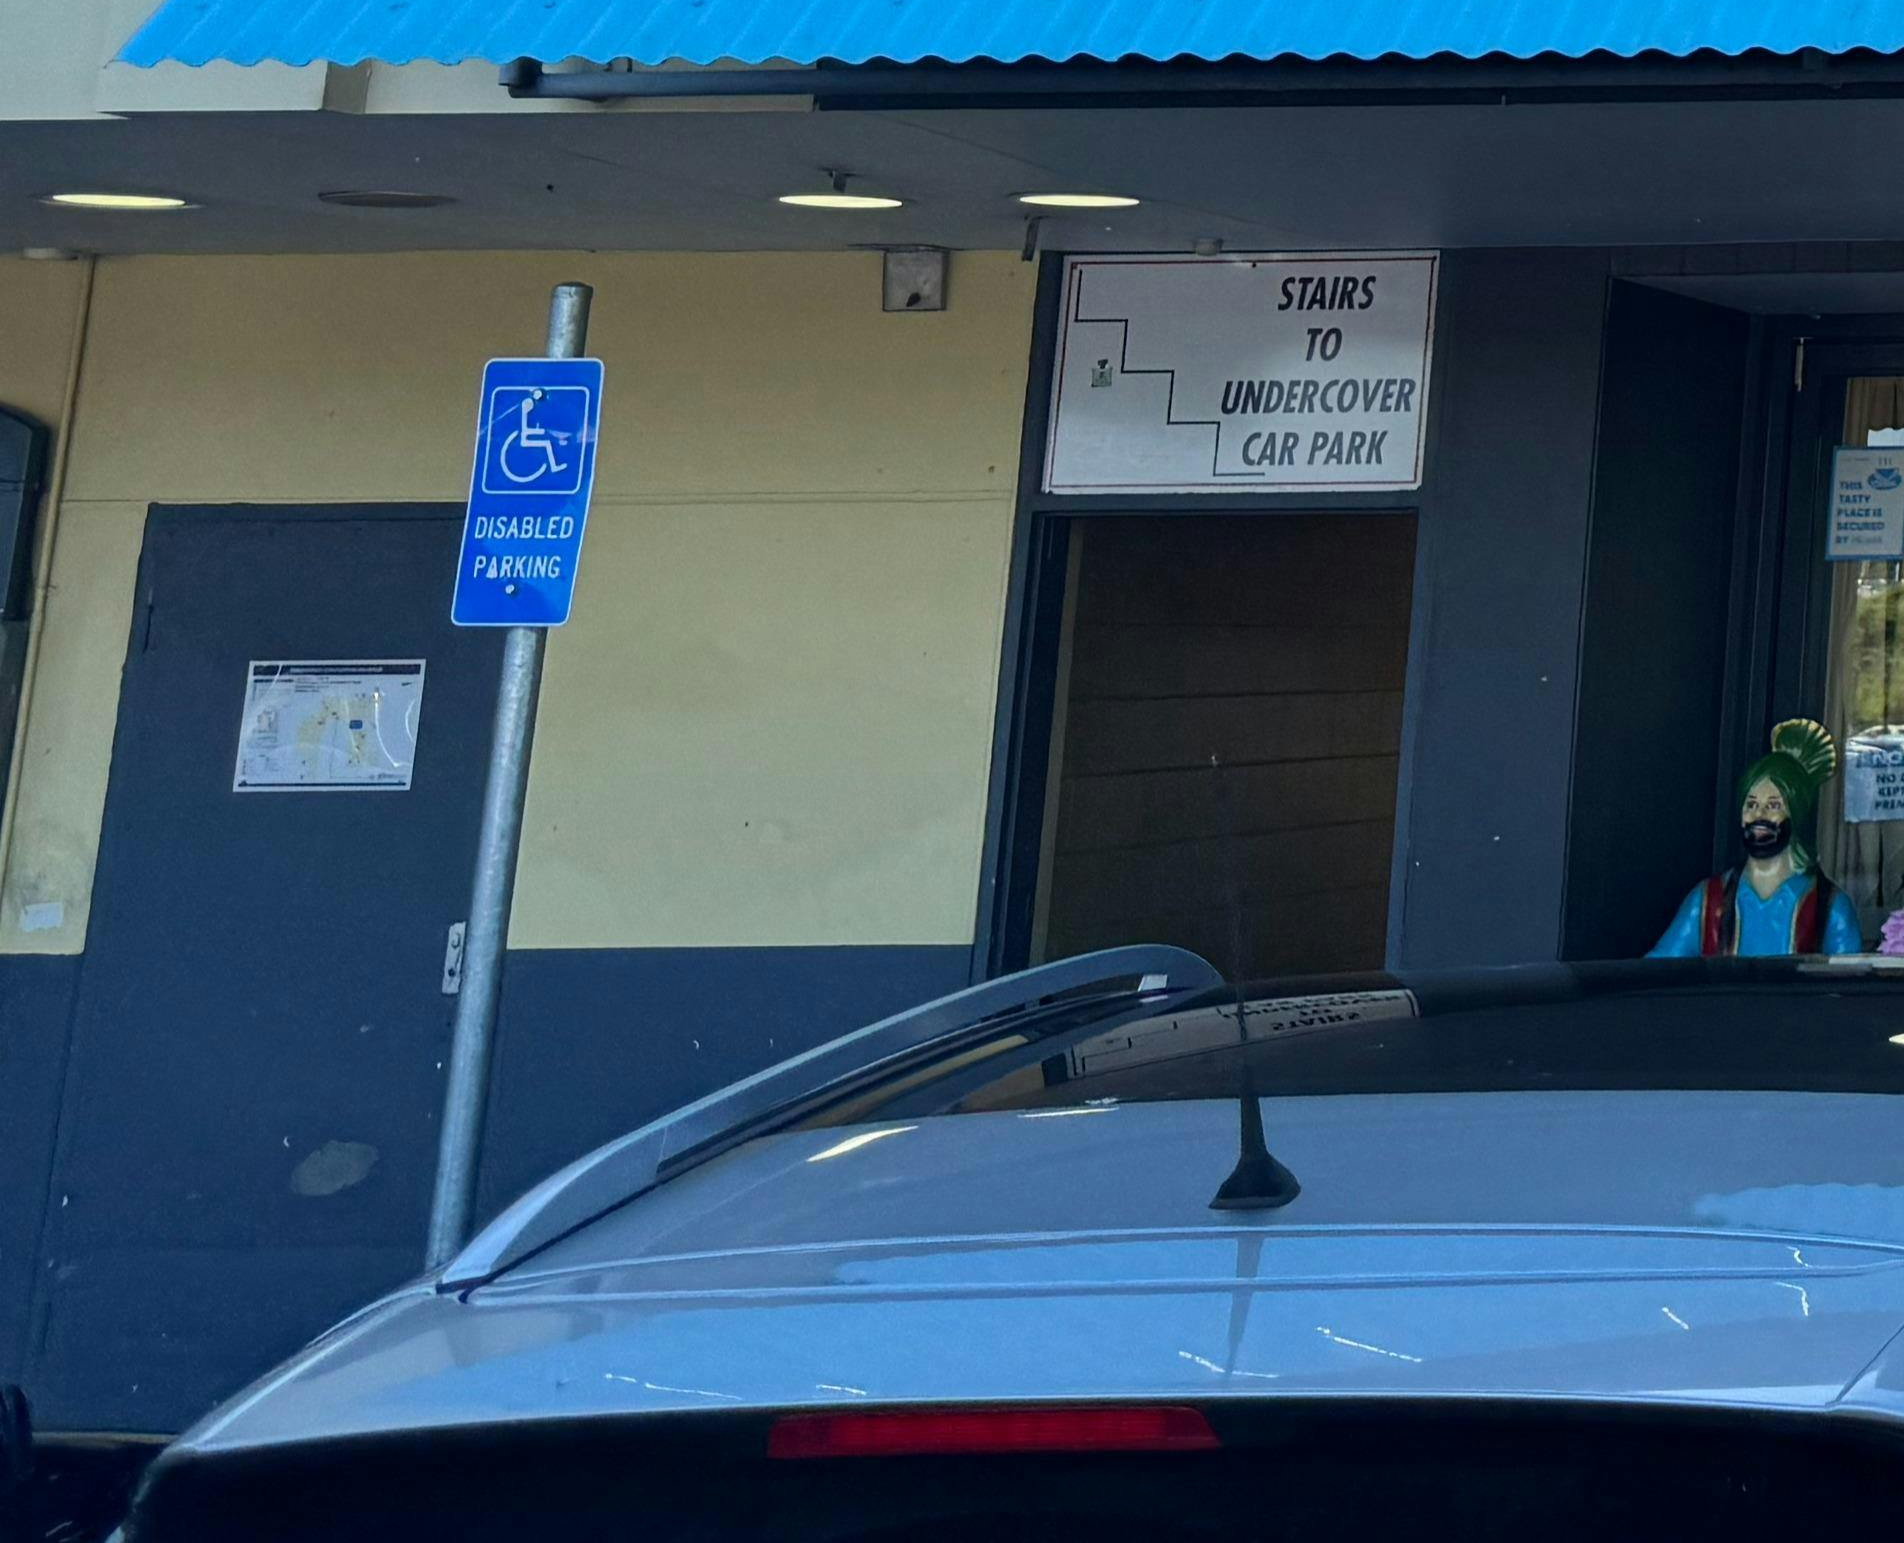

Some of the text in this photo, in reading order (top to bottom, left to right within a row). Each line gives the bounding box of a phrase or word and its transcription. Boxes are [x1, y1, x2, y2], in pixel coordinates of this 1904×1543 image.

[1278, 276, 1376, 311] STAIRS
[1305, 327, 1343, 361] TO
[1221, 378, 1416, 414] UNDERCOVER
[1242, 430, 1388, 466] CAR PARK
[1839, 494, 1871, 504] TASTY
[1837, 508, 1870, 517] PLACE
[474, 516, 574, 539] DISABLED
[1836, 522, 1885, 531] SECURED
[473, 555, 561, 579] PARKING
[1876, 773, 1896, 783] NO
[1878, 786, 1904, 797] KEPT
